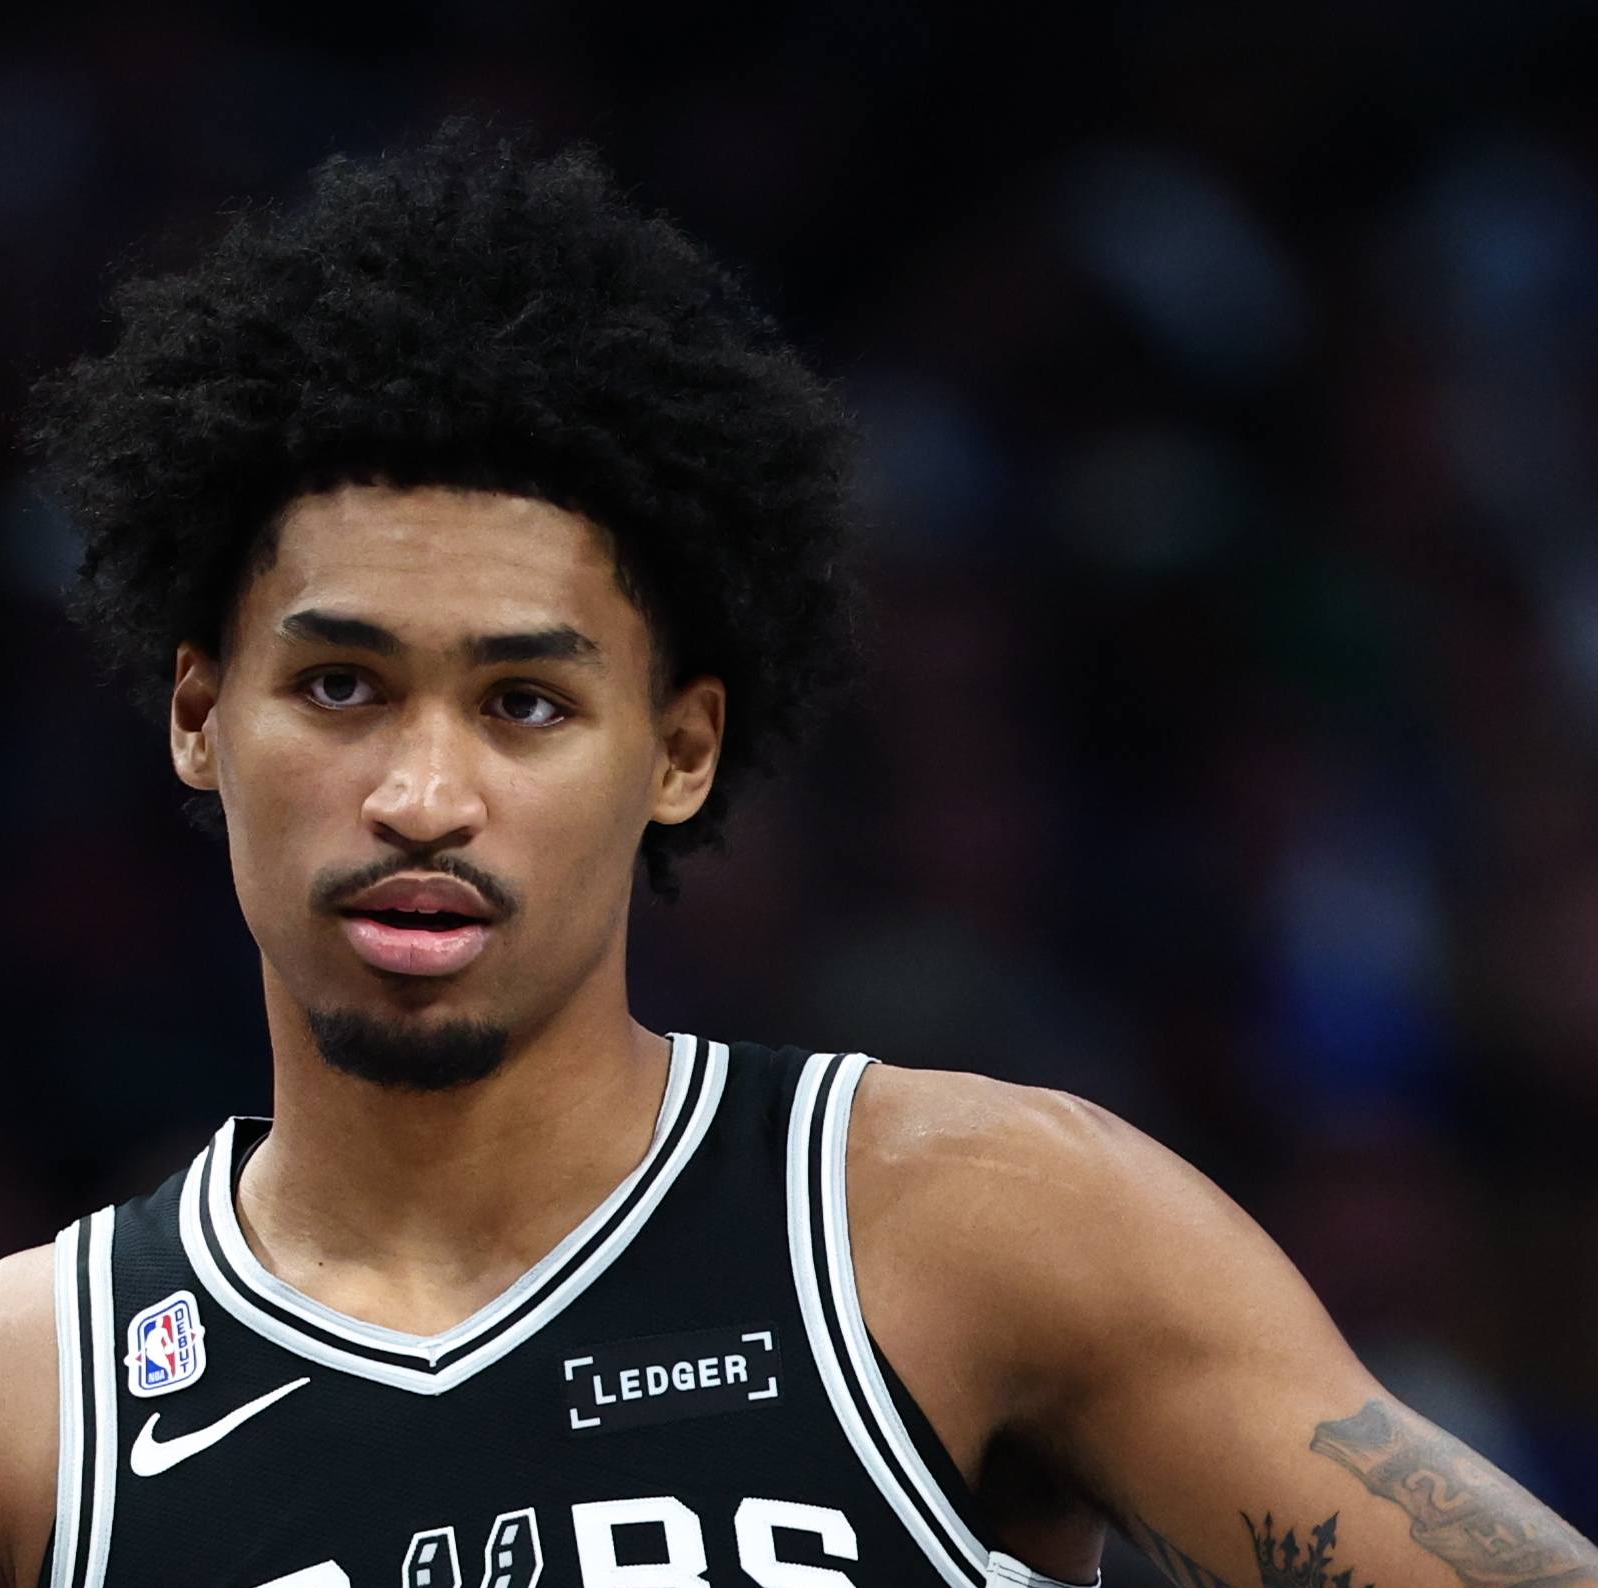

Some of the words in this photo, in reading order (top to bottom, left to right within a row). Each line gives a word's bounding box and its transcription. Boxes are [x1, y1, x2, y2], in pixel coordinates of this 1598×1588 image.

[175, 1308, 189, 1373] DEBUT
[148, 1369, 166, 1383] NBA
[592, 1354, 749, 1406] LEDGER
